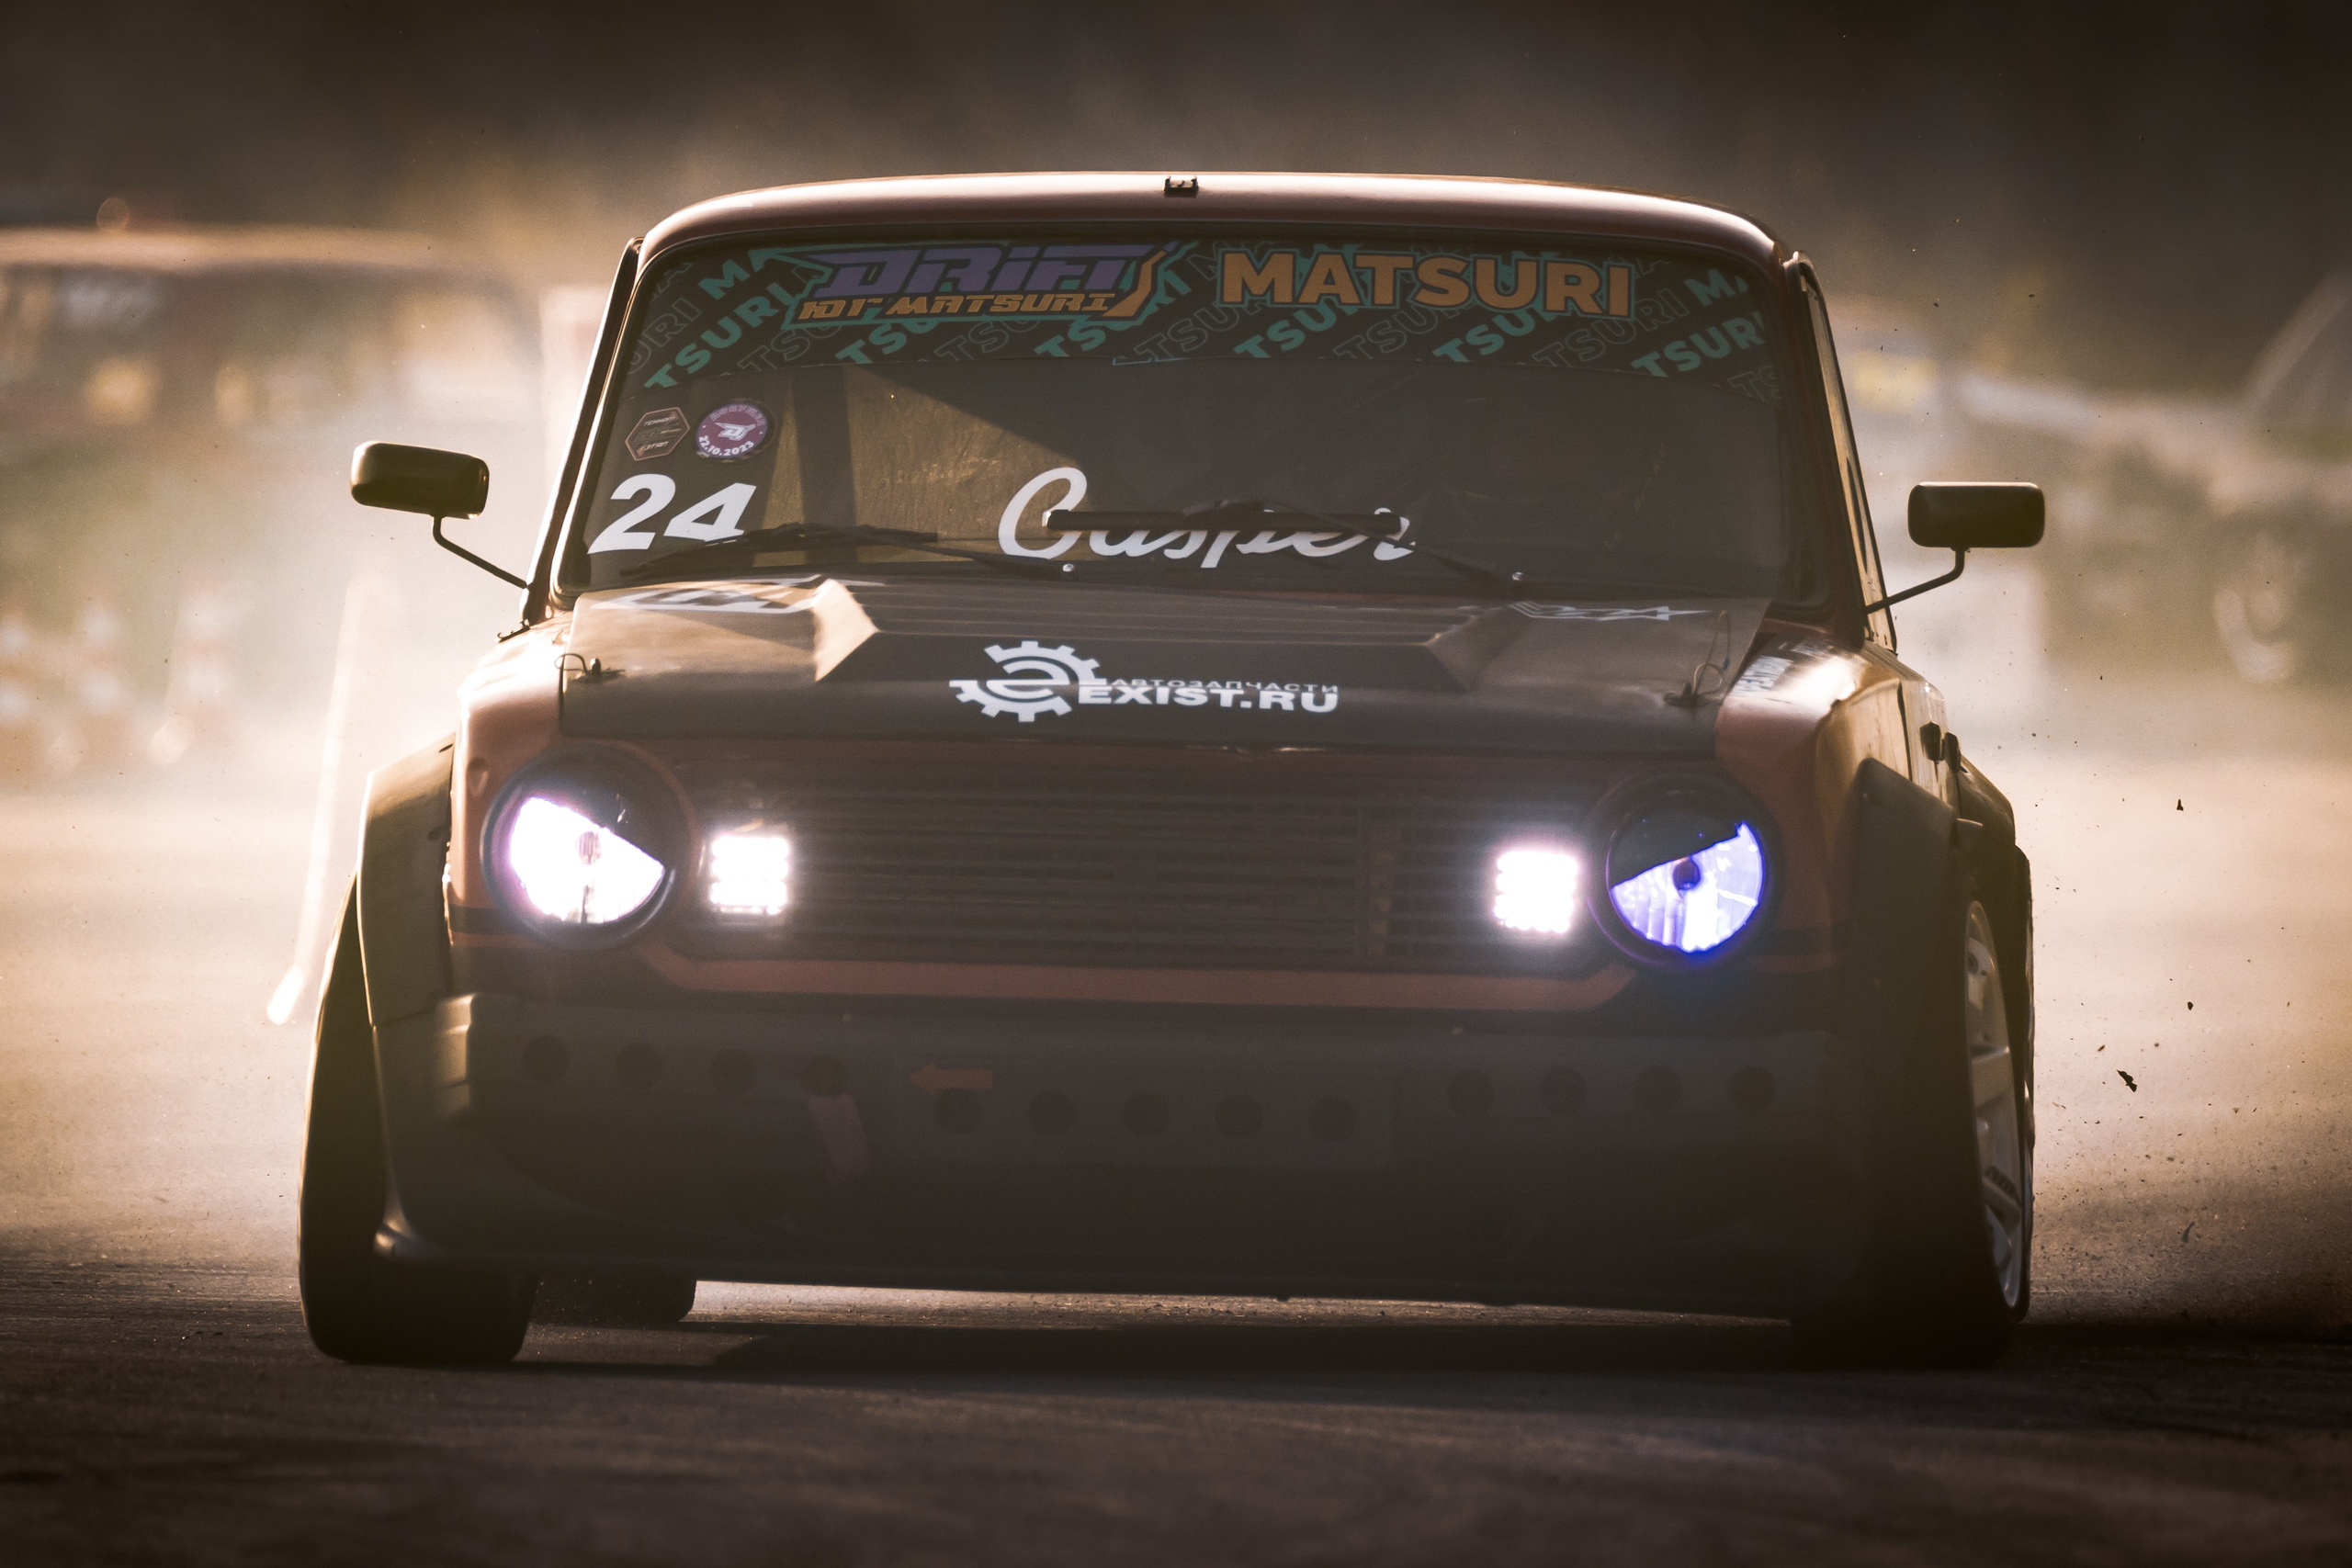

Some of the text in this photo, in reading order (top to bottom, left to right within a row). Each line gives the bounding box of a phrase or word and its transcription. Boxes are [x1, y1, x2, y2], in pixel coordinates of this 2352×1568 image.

[1223, 252, 1630, 318] MATSURI
[884, 293, 1115, 315] MATSURI
[587, 473, 757, 555] 24
[1078, 684, 1339, 713] EXIST.RU
[1105, 678, 1339, 693] АВТОЗАПЧАСТИ
